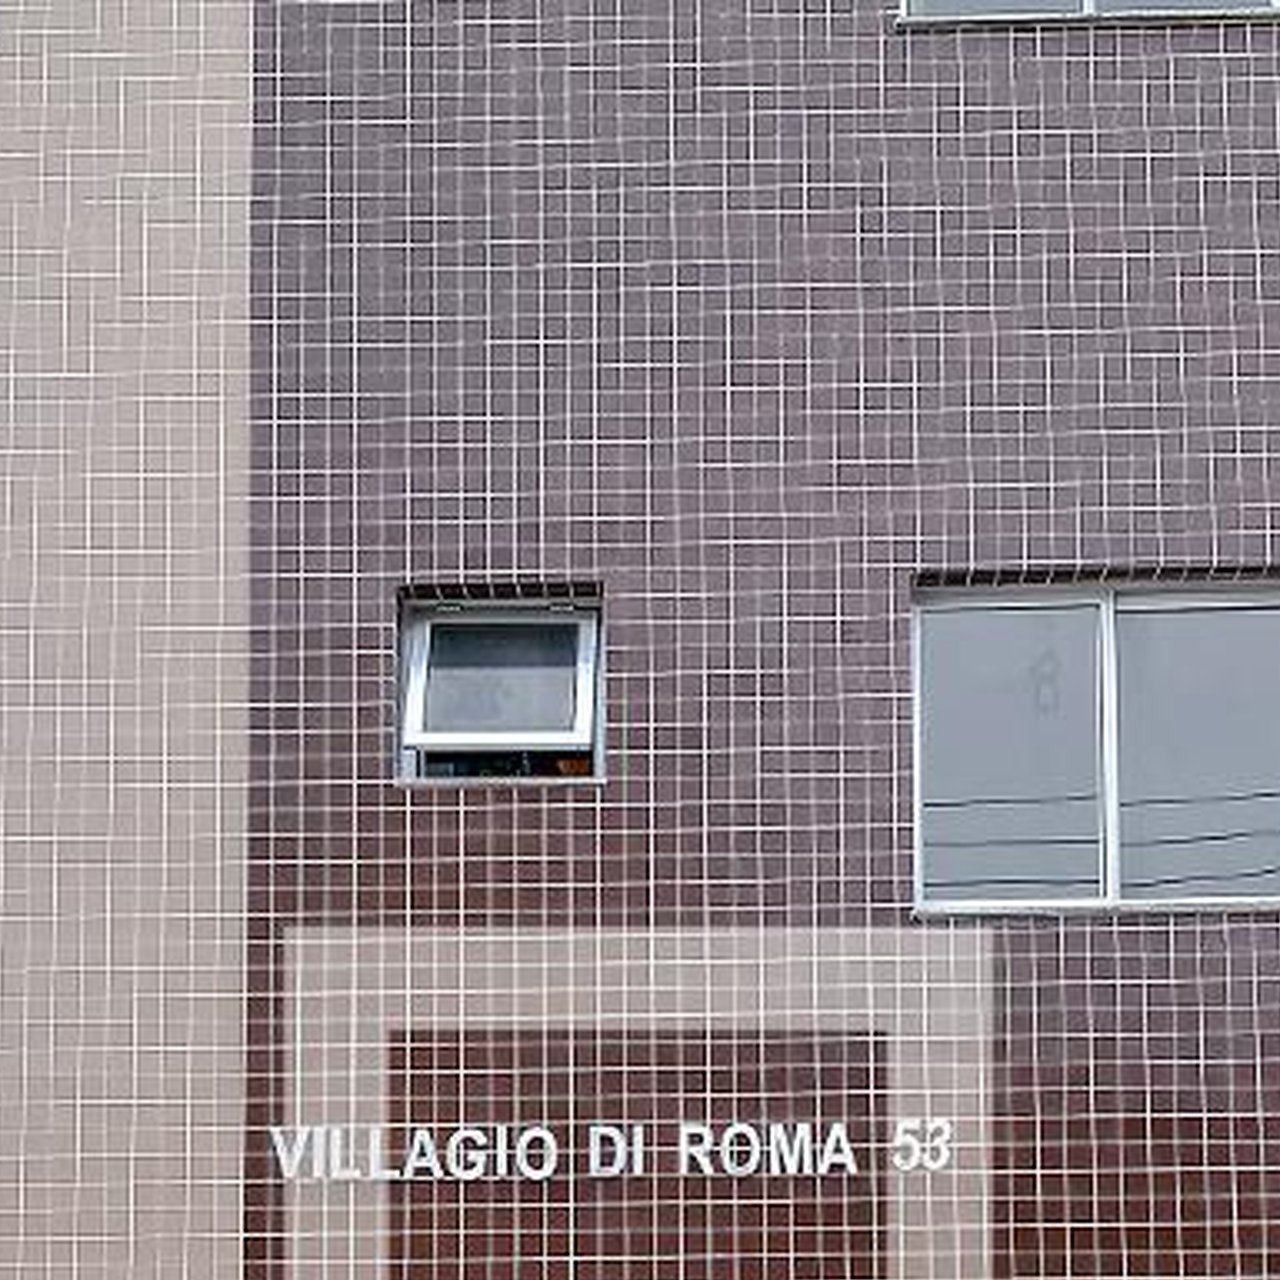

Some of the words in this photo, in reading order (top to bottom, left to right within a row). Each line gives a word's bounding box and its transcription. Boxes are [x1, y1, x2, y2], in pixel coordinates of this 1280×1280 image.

[270, 1125, 558, 1182] VILLAGIO
[587, 1124, 643, 1178] DI
[677, 1121, 860, 1178] ROMA
[891, 1117, 955, 1172] 53
